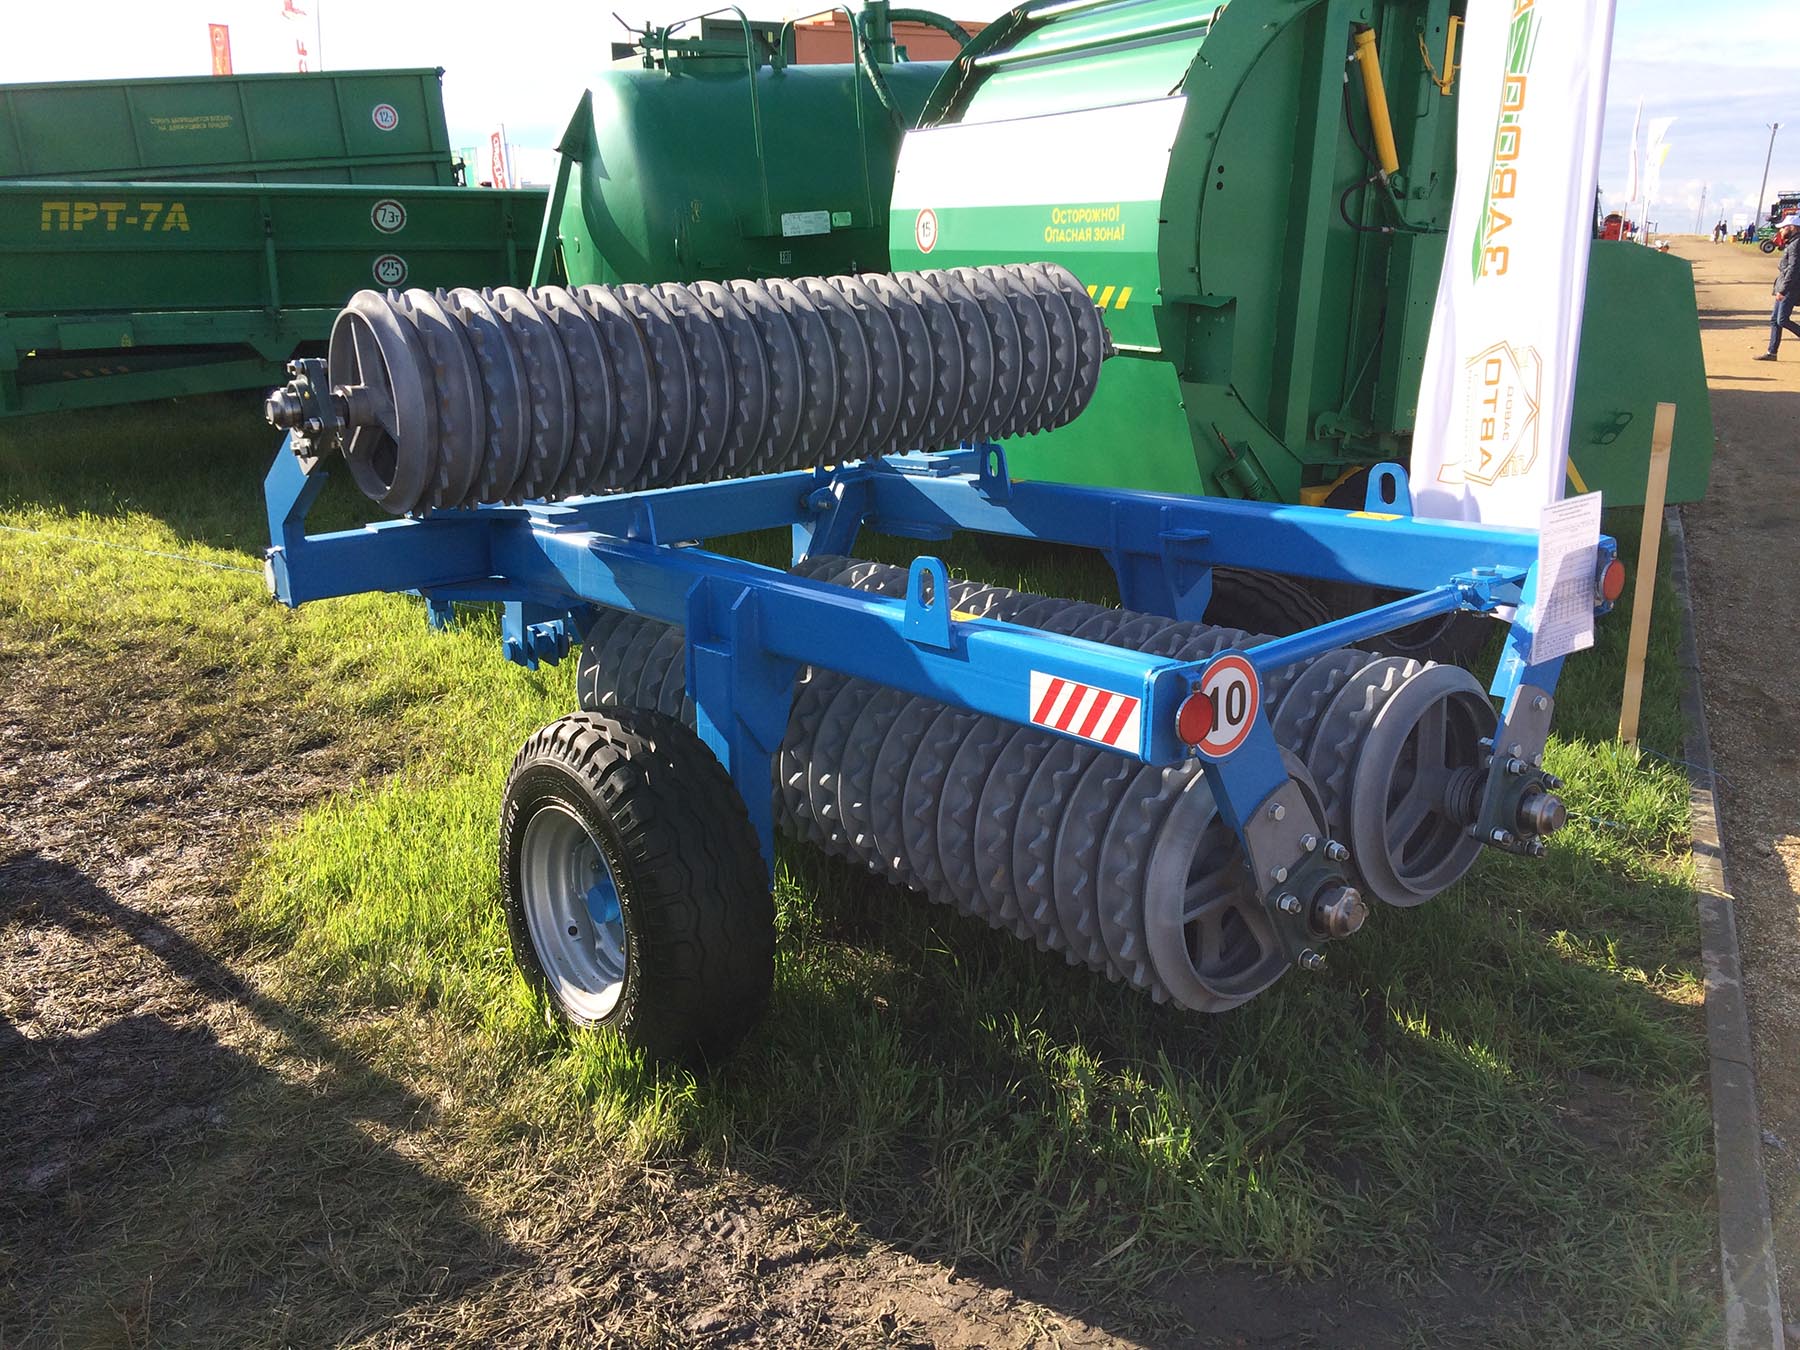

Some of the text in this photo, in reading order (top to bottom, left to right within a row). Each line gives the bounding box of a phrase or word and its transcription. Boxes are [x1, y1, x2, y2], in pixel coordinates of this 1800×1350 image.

[41, 202, 190, 231] ПРТ-7А
[922, 221, 931, 238] 15
[382, 262, 400, 276] 25
[1209, 680, 1247, 732] 10
